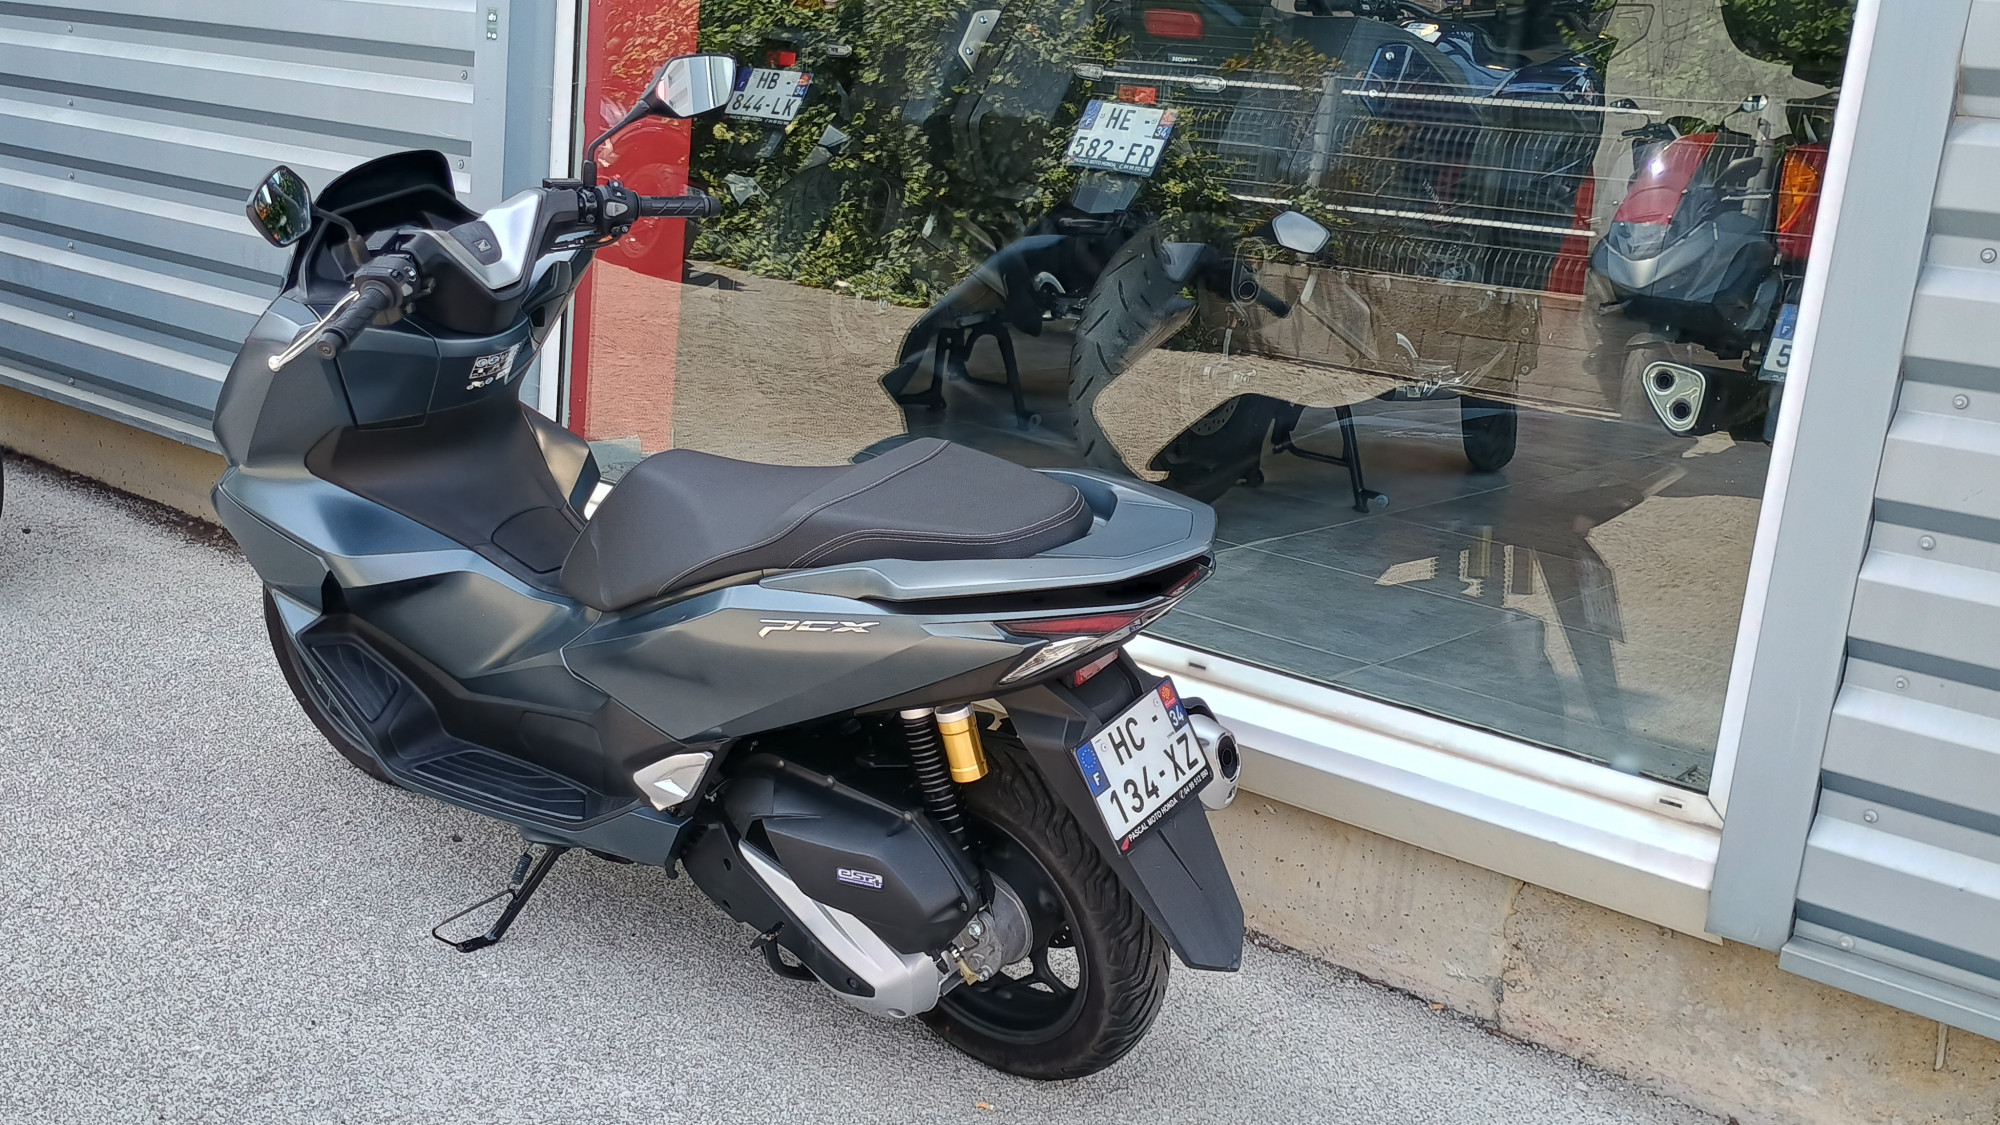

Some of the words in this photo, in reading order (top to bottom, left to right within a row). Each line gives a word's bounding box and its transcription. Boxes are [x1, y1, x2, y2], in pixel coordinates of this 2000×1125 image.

[756, 72, 780, 89] HB
[794, 86, 805, 95] 34
[732, 94, 796, 116] 844-LK
[1105, 107, 1136, 131] HE
[1155, 126, 1167, 137] 34
[1073, 136, 1155, 166] 582-FR
[1782, 326, 1790, 334] F
[758, 619, 880, 638] PCX
[1169, 705, 1184, 727] 34
[1107, 717, 1145, 766] HC
[1093, 772, 1100, 786] F
[1110, 732, 1199, 824] 134-XZ
[1128, 822, 1148, 842] PASCAL
[1147, 810, 1162, 826] MOTO
[1161, 797, 1179, 815] HONDA
